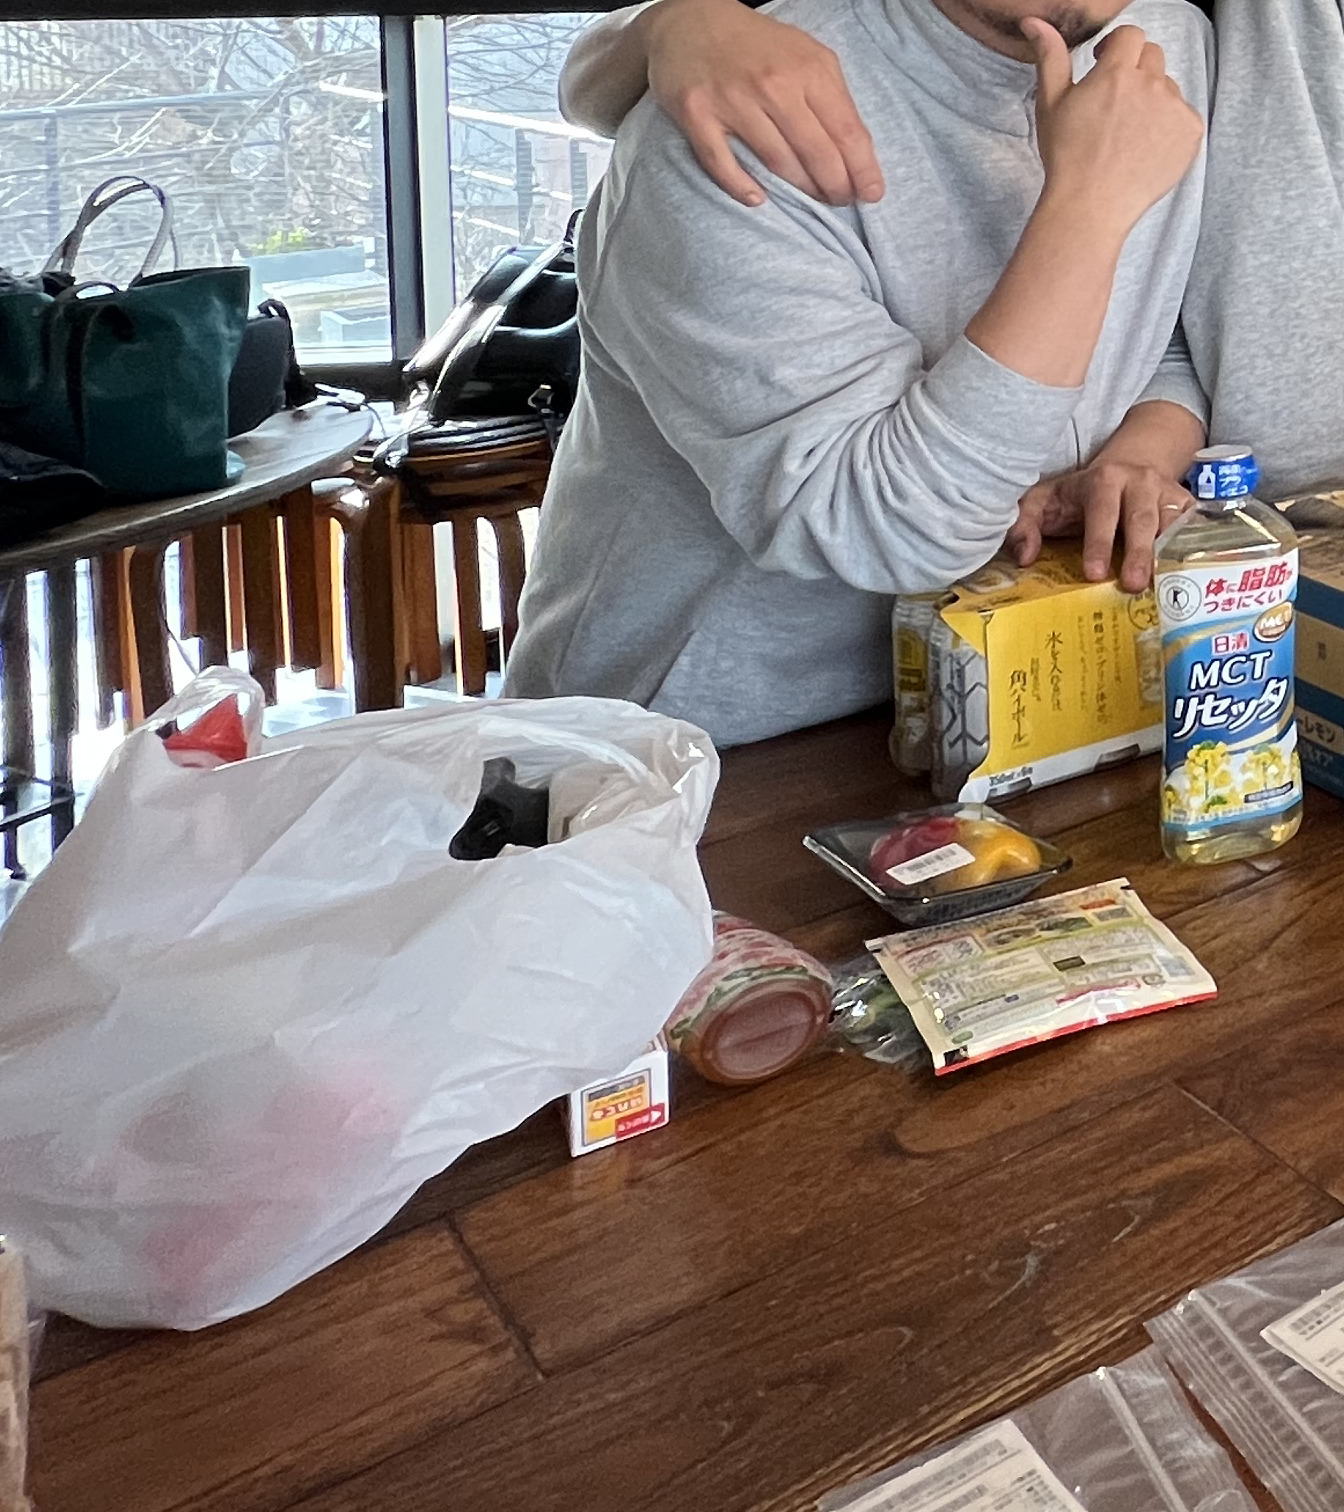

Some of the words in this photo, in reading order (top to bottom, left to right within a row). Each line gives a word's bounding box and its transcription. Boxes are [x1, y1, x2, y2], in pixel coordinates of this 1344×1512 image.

[1203, 589, 1284, 614] つきにくい
[1213, 635, 1249, 654] 日清
[1190, 651, 1273, 691] MCT
[1172, 677, 1290, 738] リセッタ
